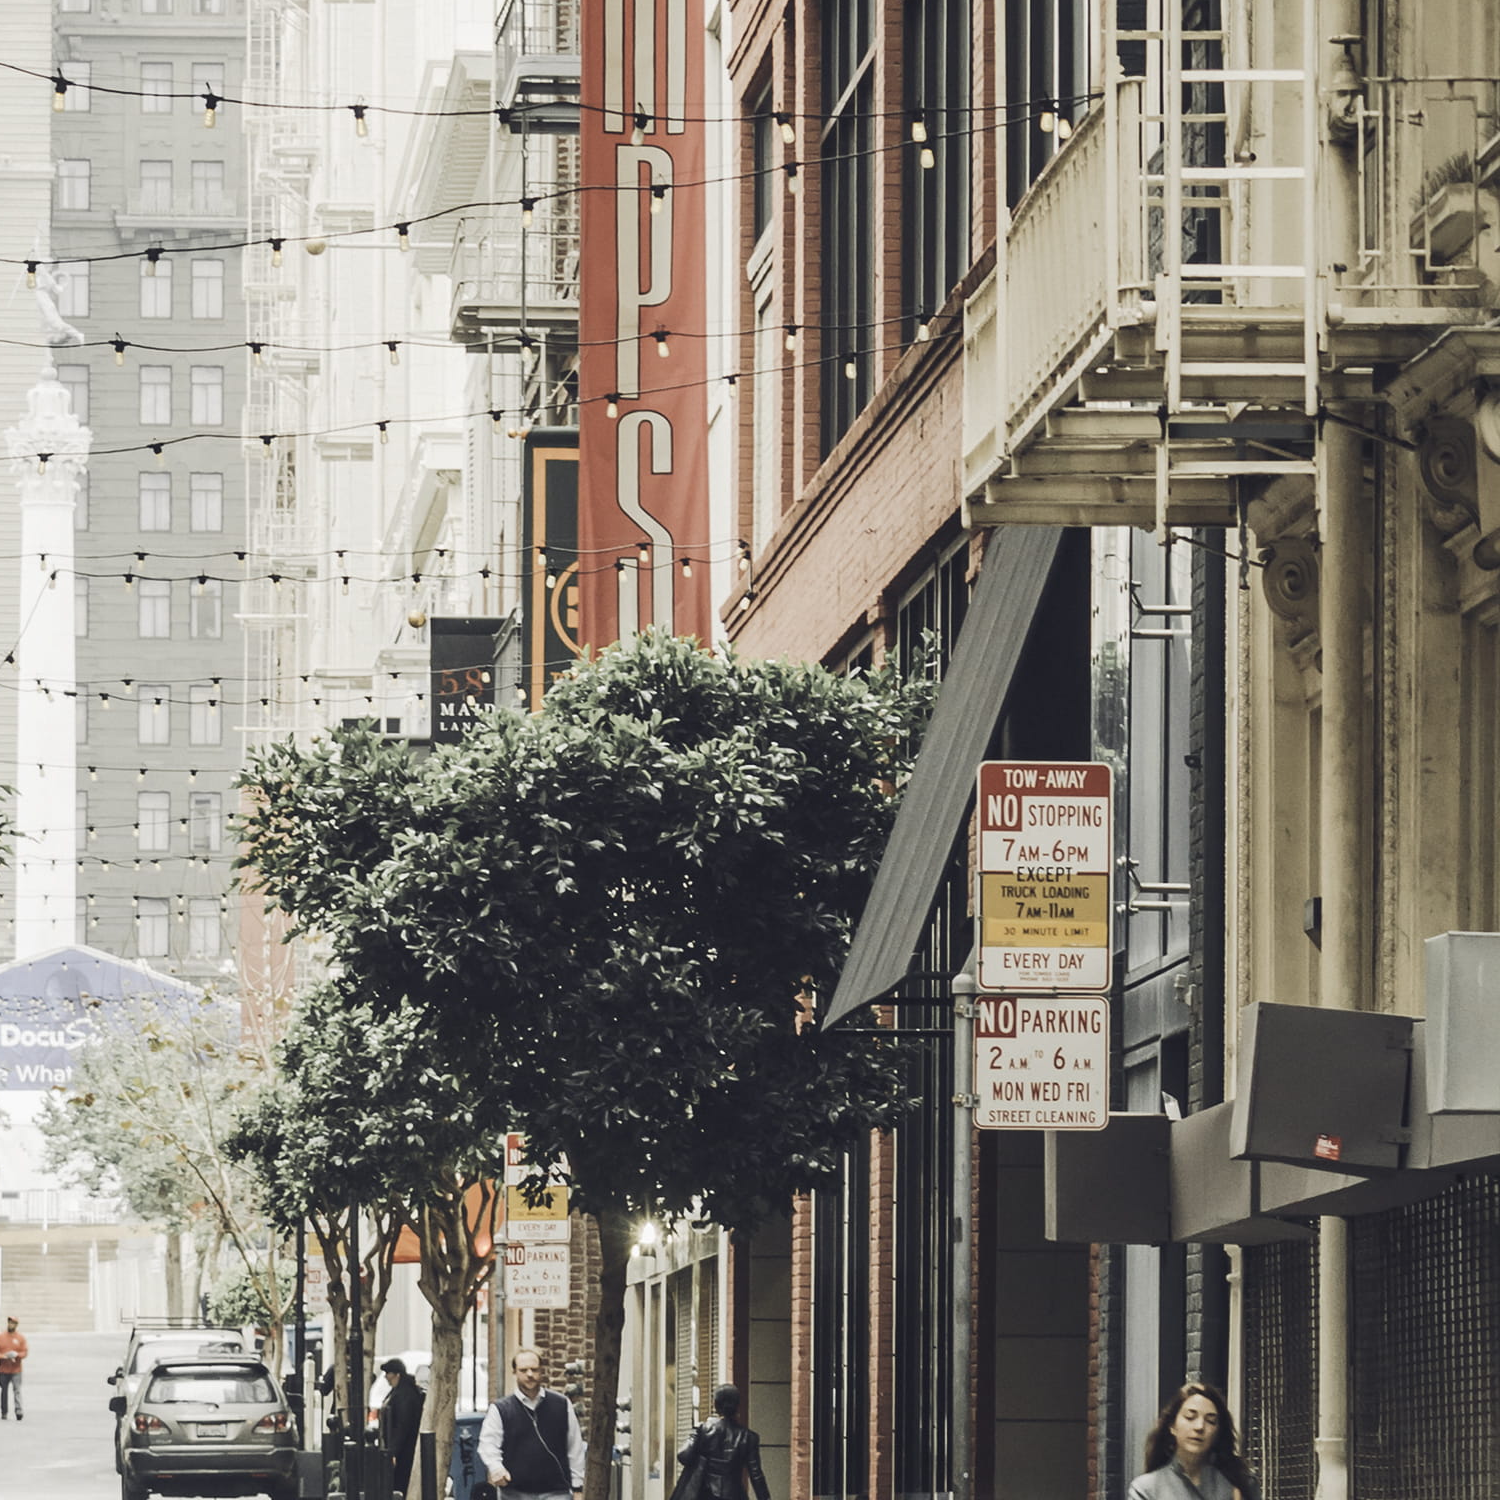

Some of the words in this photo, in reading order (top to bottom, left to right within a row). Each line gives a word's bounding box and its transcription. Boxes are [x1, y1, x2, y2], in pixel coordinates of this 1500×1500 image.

[440, 667, 484, 697] 58
[1003, 769, 1087, 788] TOW-AWAY
[988, 794, 1018, 827] NO
[1028, 804, 1102, 827] STOPPING
[1016, 866, 1073, 882] EXCEPT
[1001, 885, 1037, 898] TRUCK
[1043, 886, 1090, 899] LOADING
[1004, 927, 1016, 936] 30
[1022, 927, 1058, 936] MINUTE
[1064, 928, 1090, 937] LIMIT
[1003, 953, 1051, 969] EVERY
[1059, 953, 1085, 969] DAY
[980, 1000, 1015, 1034] NO
[1021, 1010, 1101, 1034] PARKING
[989, 1046, 1002, 1070] 2
[1053, 1046, 1066, 1070] 6
[15, 1064, 74, 1084] What
[992, 1081, 1024, 1102] MON
[1030, 1081, 1061, 1102] WED
[1067, 1082, 1090, 1102] FRI
[989, 1110, 1031, 1123] STREET
[1035, 1111, 1097, 1124] CLEANING
[507, 1247, 525, 1264] NO
[527, 1250, 565, 1262] PARKING
